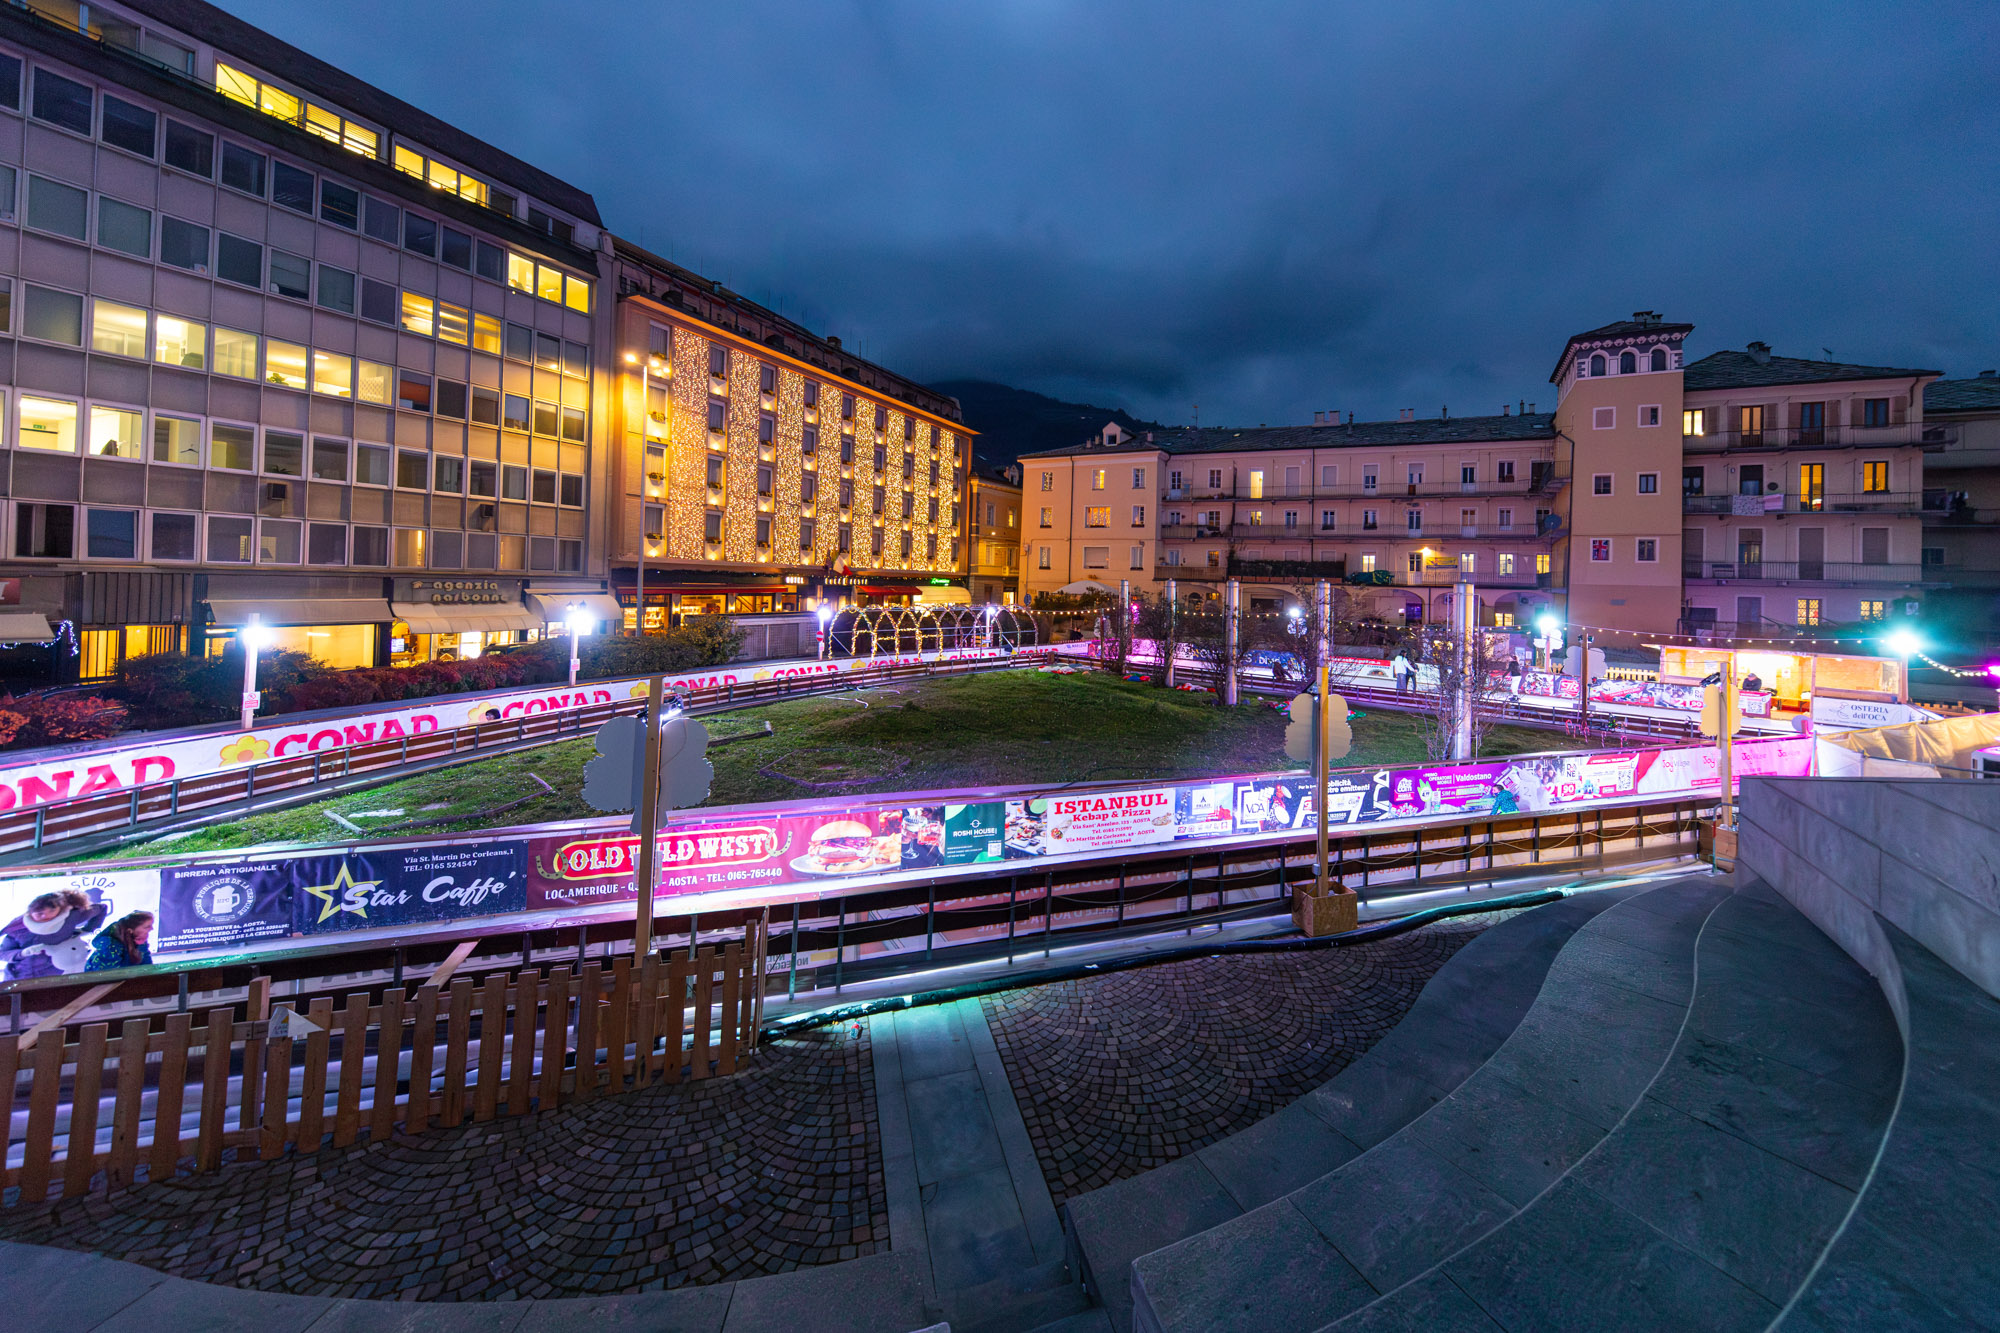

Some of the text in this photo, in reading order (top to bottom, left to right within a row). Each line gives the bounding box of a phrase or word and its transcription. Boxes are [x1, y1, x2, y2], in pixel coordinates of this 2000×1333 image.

[433, 580, 498, 592] agenzia
[773, 665, 838, 678] CONAD
[502, 690, 611, 720] CONAD
[1851, 704, 1889, 714] OSTERIA
[1852, 713, 1887, 722] dell'OCA
[274, 714, 439, 759] CONAD
[1455, 773, 1492, 782] Valdostano
[1340, 783, 1370, 792] emittenti
[1053, 793, 1168, 815] ISTANBUL
[1072, 808, 1151, 823] Kebap & Pizza
[974, 827, 995, 835] HOUSE
[431, 853, 458, 861] Martin
[459, 851, 470, 859] De
[568, 847, 625, 872] OLD
[698, 833, 769, 859] WEST
[446, 860, 477, 869] 524547
[174, 864, 277, 879] BIRRERIA ARTIGIANALE
[545, 884, 618, 900] LOC.AMERIQUE
[668, 875, 697, 887] AOSTA
[707, 871, 725, 882] TEL:
[727, 867, 783, 882] 0165-765440
[340, 882, 413, 912] Star
